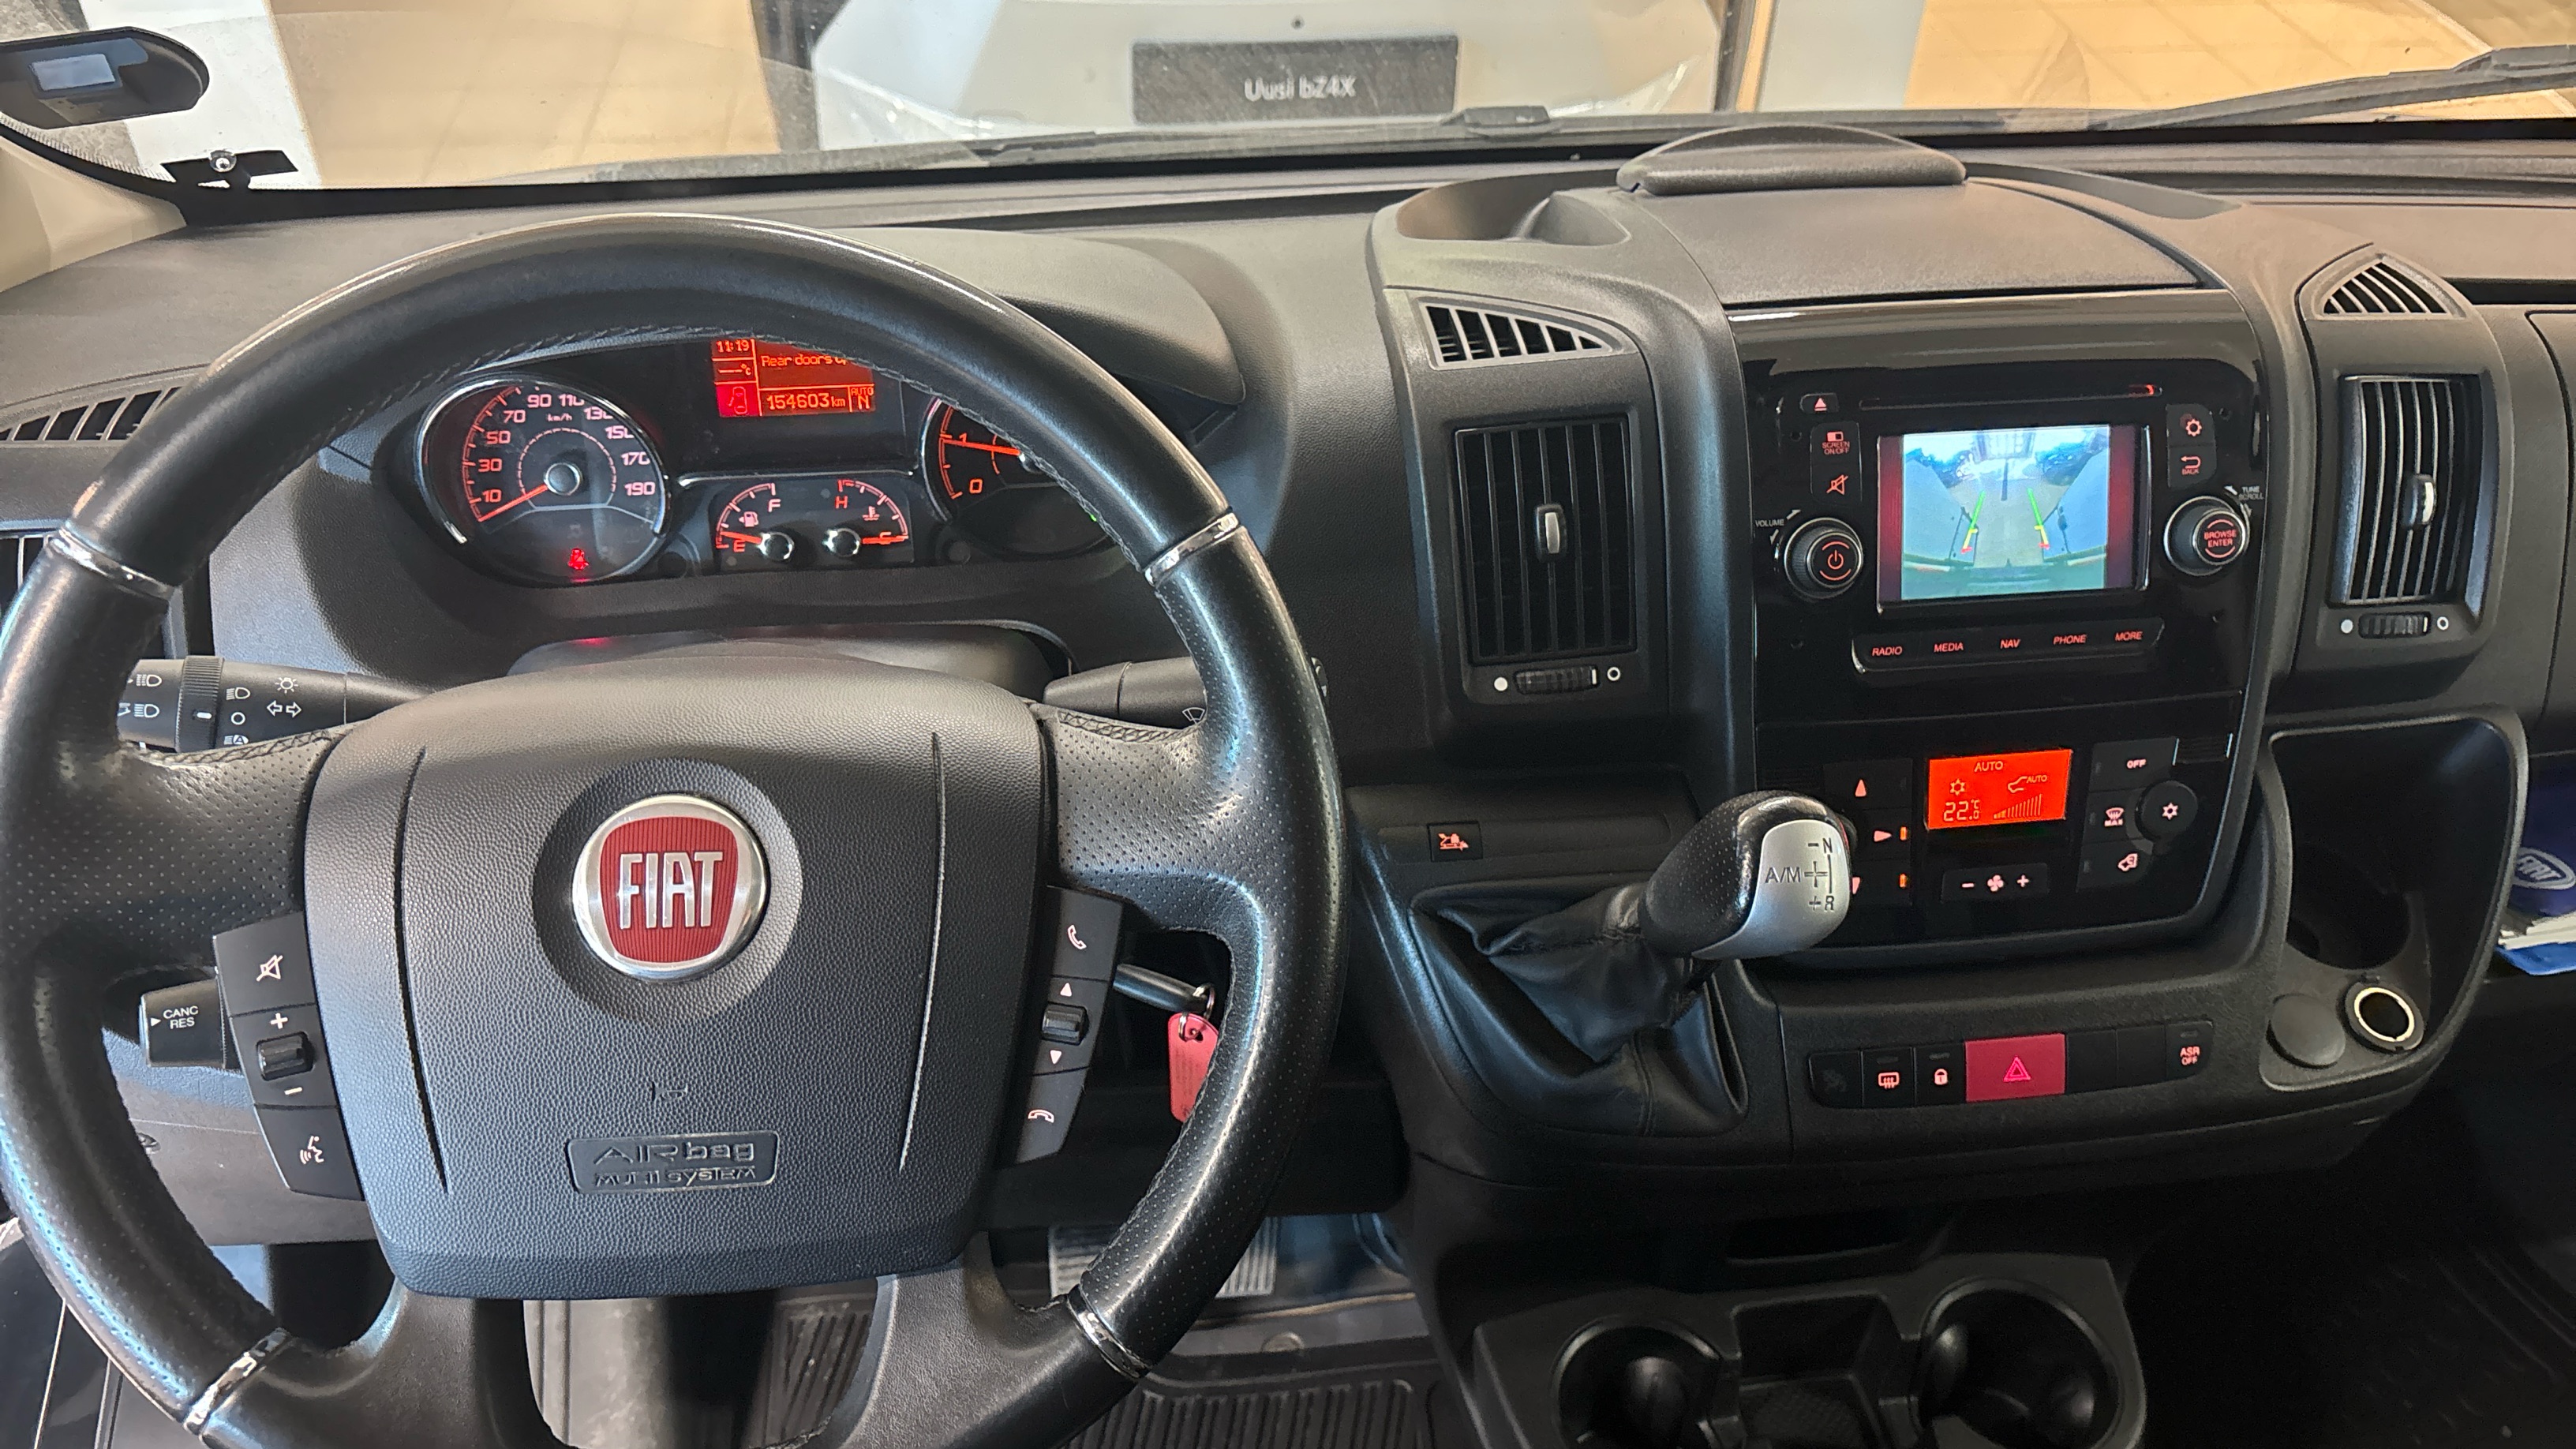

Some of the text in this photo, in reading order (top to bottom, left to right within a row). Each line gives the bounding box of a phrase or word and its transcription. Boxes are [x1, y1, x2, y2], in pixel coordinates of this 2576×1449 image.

[1245, 74, 1357, 102] Uusi bZ4X
[716, 340, 750, 353] 11:19
[761, 355, 792, 366] Rear
[795, 354, 833, 365] doors
[850, 387, 874, 396] AUTO
[527, 394, 552, 408] 90
[767, 393, 845, 410] 154603 km
[858, 395, 871, 410] N
[504, 410, 526, 424] 70
[548, 413, 573, 422] km/h
[486, 430, 511, 444] 50
[1822, 441, 1851, 450] SCREEN
[477, 458, 503, 472] 30
[623, 481, 656, 496] 190
[969, 478, 983, 493] 0
[482, 489, 502, 503] 10
[835, 496, 848, 509] H
[2238, 492, 2264, 501] SCROLL
[768, 499, 781, 512] F
[1755, 519, 1784, 527] VOLUME
[2203, 530, 2237, 540] BROWSE
[733, 541, 746, 552] E
[2207, 538, 2233, 548] ENTER
[2053, 634, 2087, 645] PHONE
[2115, 631, 2144, 642] MORE
[1934, 642, 1964, 653] MEDIA
[2000, 638, 2020, 650] NAV
[1872, 646, 1903, 657] RADIO
[1974, 760, 2004, 773] AUTO
[2126, 758, 2147, 769] OFF
[2026, 774, 2048, 784] AUTO
[2104, 818, 2123, 827] MAX
[1822, 837, 1833, 854] N
[1765, 867, 1801, 883] A/M
[619, 852, 724, 930] FIAT
[1824, 895, 1835, 911] R
[163, 1005, 199, 1019] CANC
[170, 1017, 195, 1030] RES
[2180, 1046, 2200, 1058] ASR
[2181, 1057, 2198, 1065] OFF
